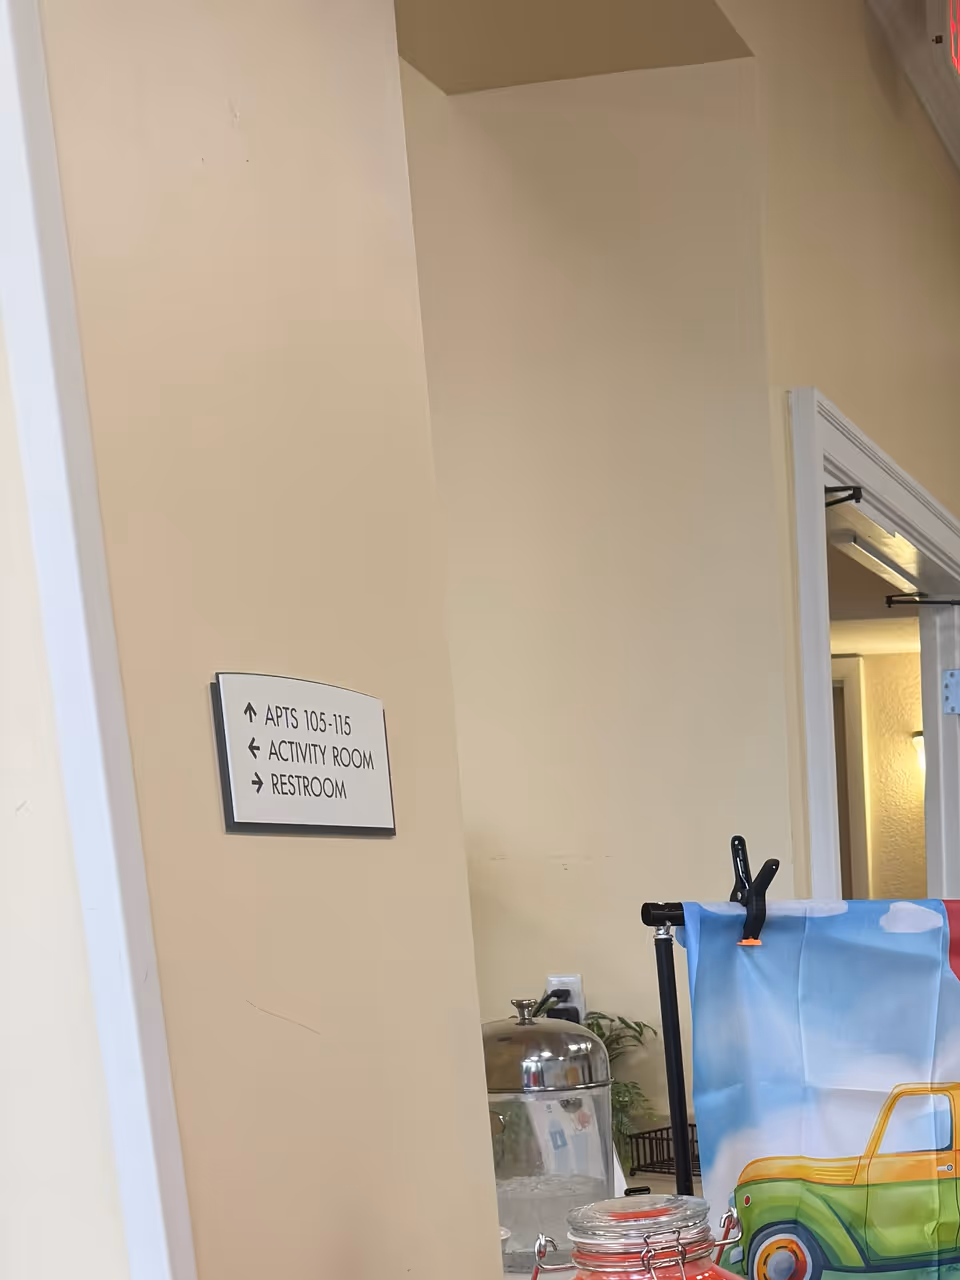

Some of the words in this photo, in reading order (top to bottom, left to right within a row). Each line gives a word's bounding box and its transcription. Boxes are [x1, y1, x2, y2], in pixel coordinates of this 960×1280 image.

[264, 703, 299, 729] APTS
[303, 709, 351, 736] 105-115
[268, 739, 327, 766] ACTIVITY
[332, 745, 375, 770] ROOM
[270, 772, 347, 799] RESTROOM
